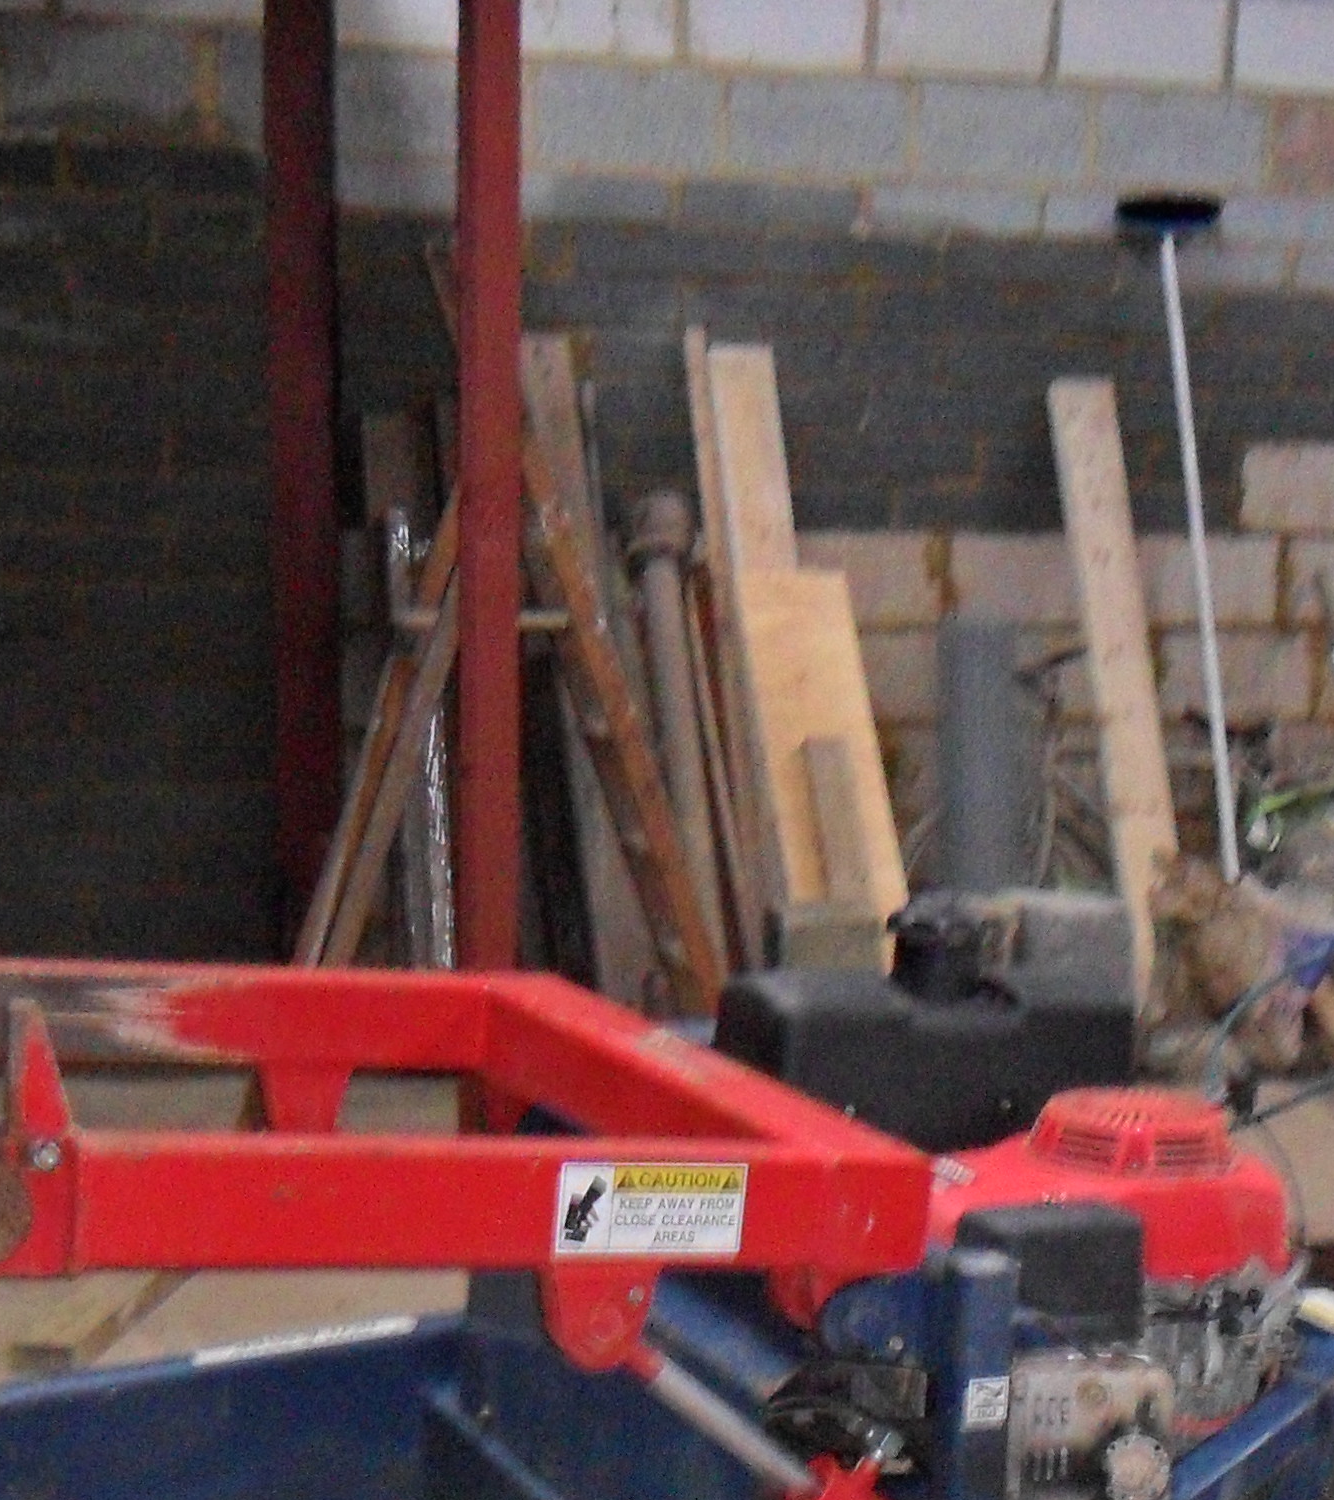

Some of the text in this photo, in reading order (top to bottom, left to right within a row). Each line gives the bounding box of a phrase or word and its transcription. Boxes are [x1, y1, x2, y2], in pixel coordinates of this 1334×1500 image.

[639, 1171, 720, 1188] CAUTION
[618, 1197, 735, 1210] KEEP AWAY FROM
[614, 1214, 737, 1226] CLOSE CLEARANCE
[653, 1230, 696, 1243] AREAS
